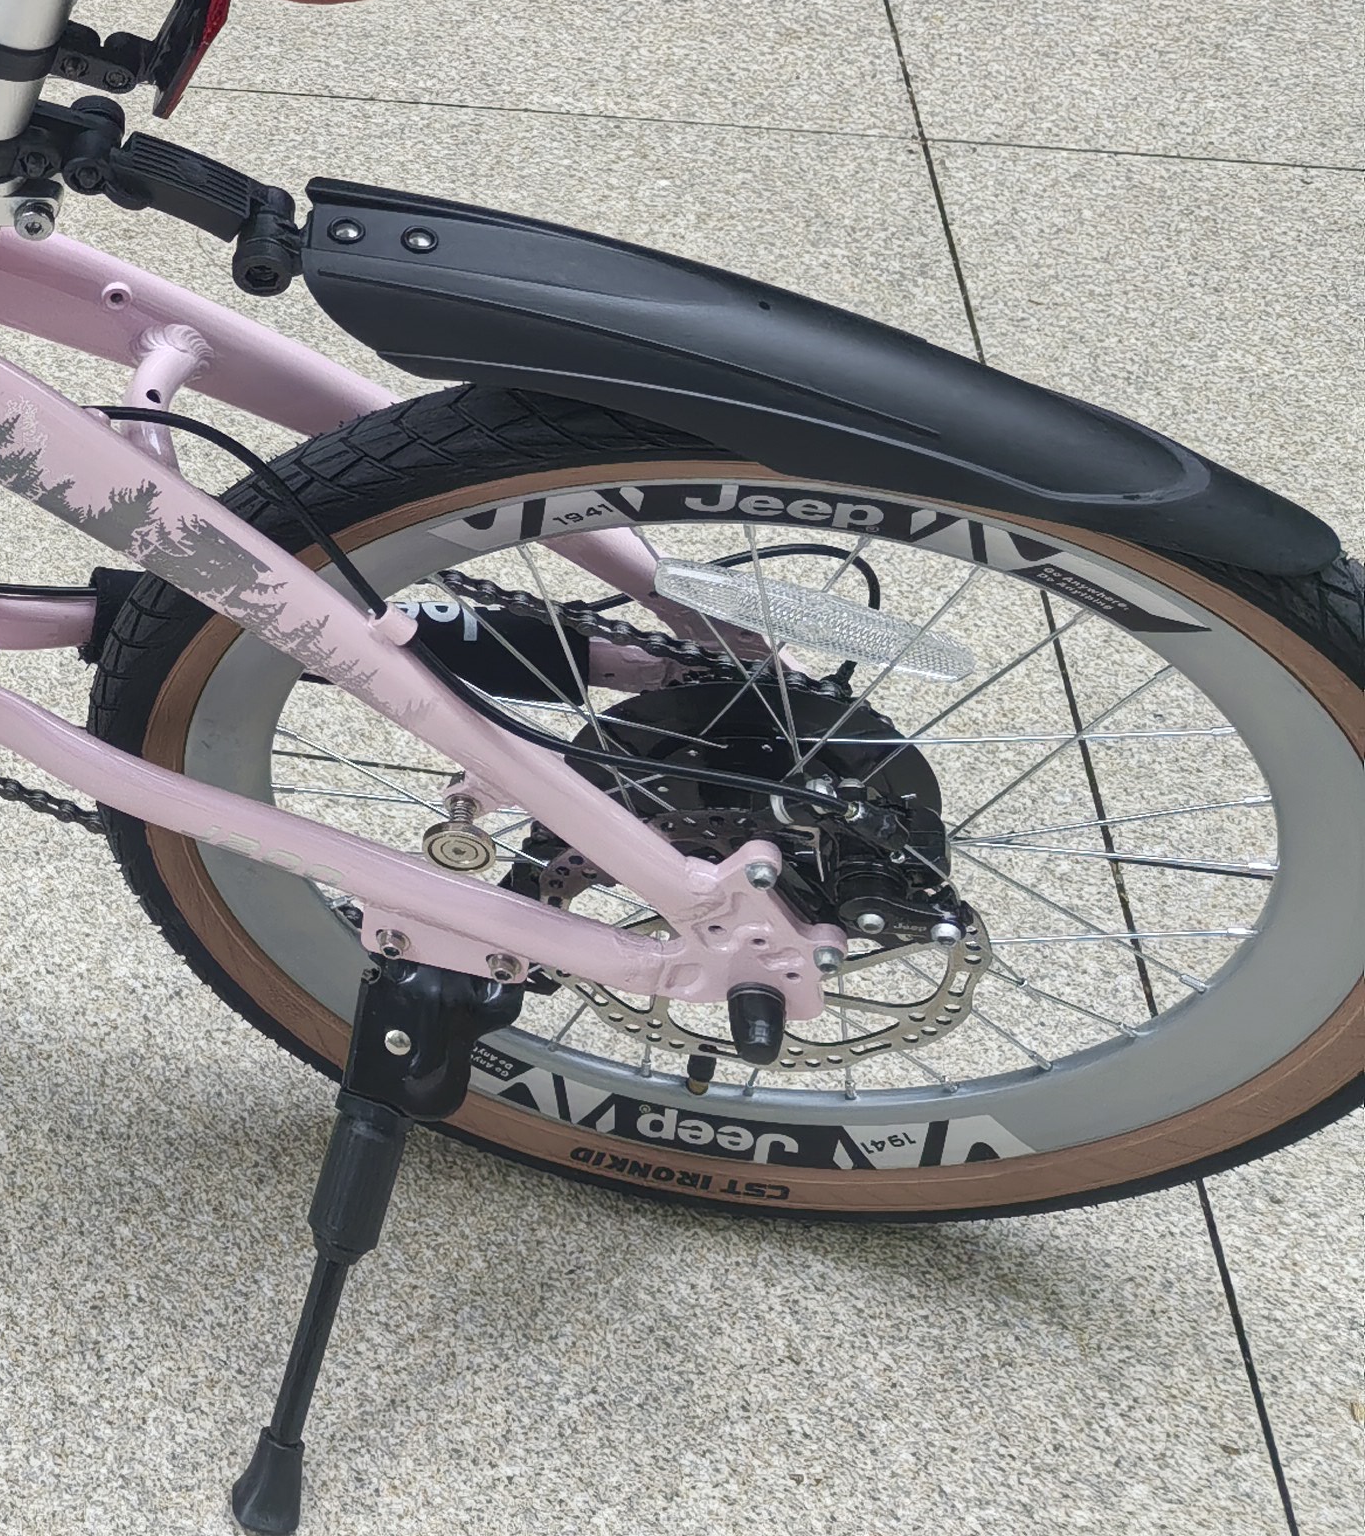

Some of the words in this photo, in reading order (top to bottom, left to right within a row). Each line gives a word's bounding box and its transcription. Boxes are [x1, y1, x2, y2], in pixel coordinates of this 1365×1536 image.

[553, 502, 615, 527] 1941
[684, 484, 885, 529] Jeep
[636, 1107, 799, 1163] Jeep
[860, 1131, 917, 1155] 1941
[569, 1146, 712, 1190] IRONKID
[720, 1180, 791, 1201] CST
